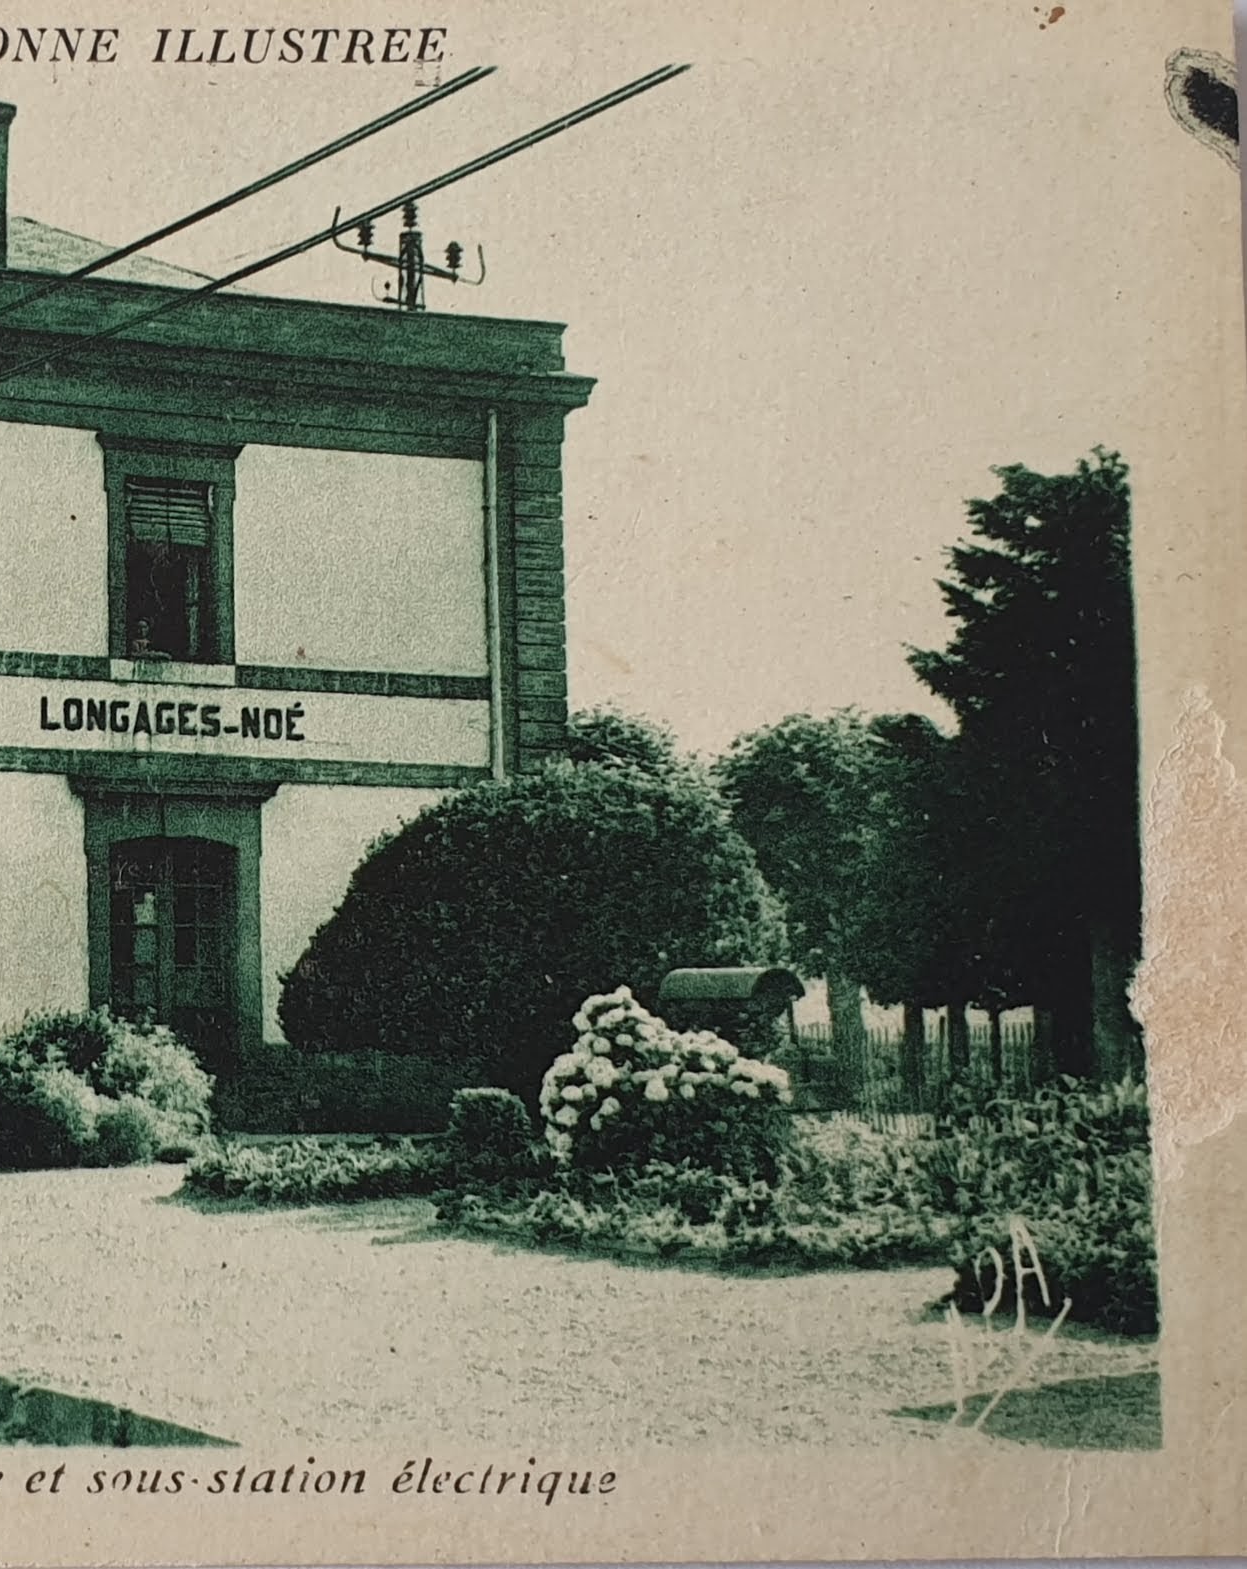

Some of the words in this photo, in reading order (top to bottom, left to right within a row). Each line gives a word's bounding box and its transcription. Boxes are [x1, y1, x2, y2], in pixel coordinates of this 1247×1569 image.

[152, 27, 448, 64] ILLUSTREE
[40, 696, 305, 742] LONGAGES-NOÉ
[25, 1463, 66, 1494] et
[391, 1457, 617, 1507] électrique
